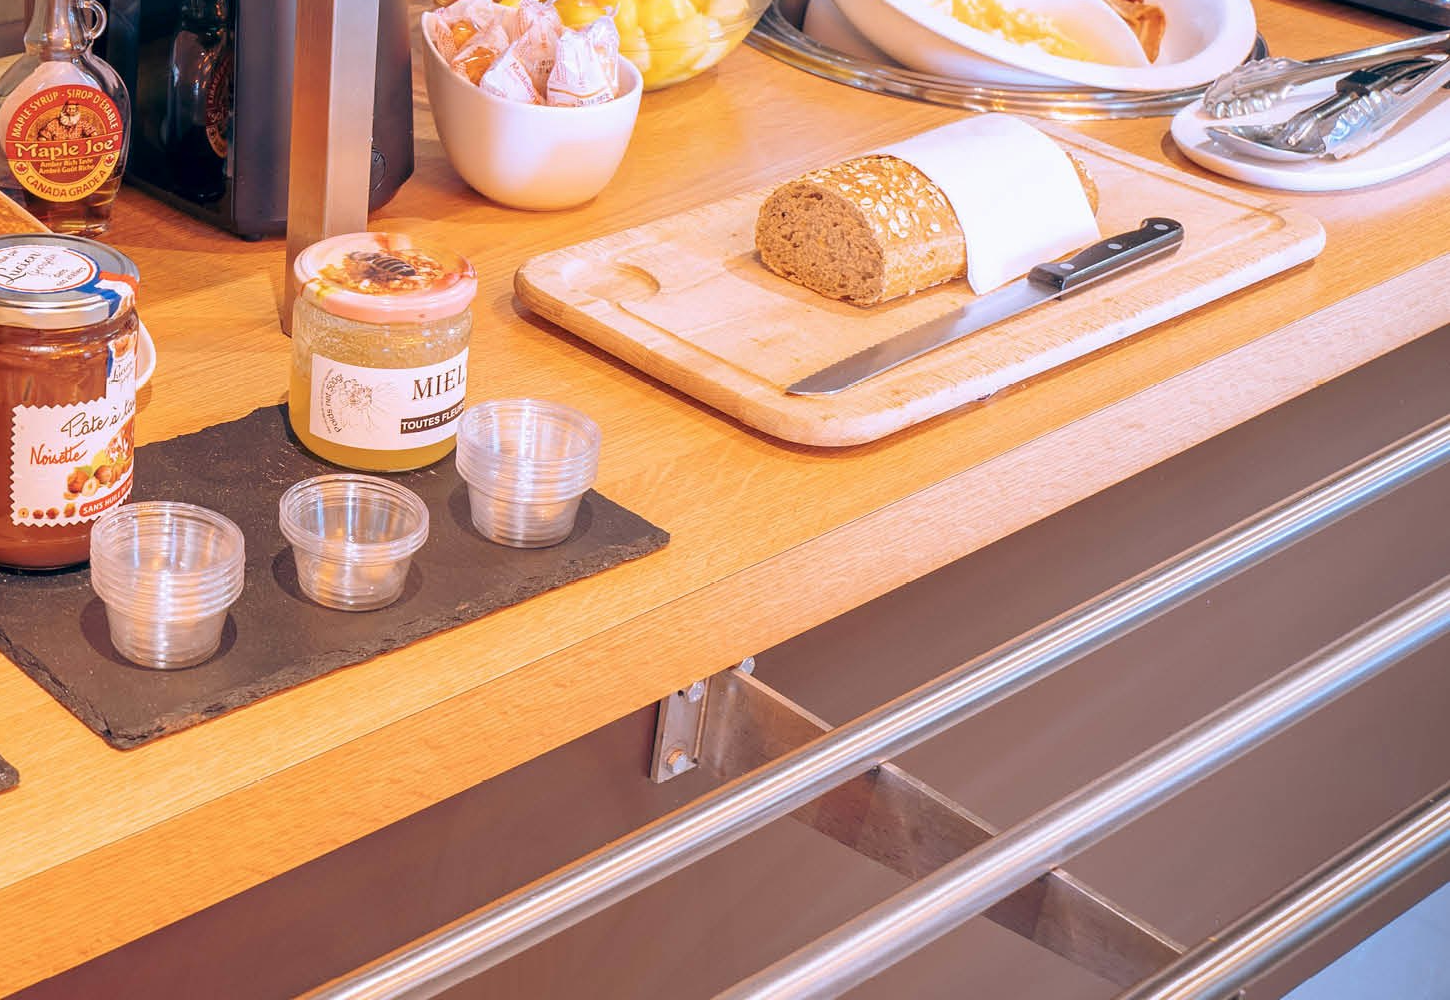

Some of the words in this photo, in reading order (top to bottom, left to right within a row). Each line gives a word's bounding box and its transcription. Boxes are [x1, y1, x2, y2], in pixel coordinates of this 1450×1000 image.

[12, 108, 32, 137] MAPLE
[30, 91, 59, 111] SYRUP
[67, 89, 93, 99] SIROP
[15, 142, 79, 160] Maple
[26, 175, 67, 198] CANADA
[68, 178, 100, 197] GRADE
[99, 169, 107, 178] A
[412, 364, 465, 401] MIEL
[60, 411, 109, 438] Pâte
[401, 415, 440, 431] TOUTES
[30, 440, 88, 466] Noisette
[83, 503, 103, 514] SANS
